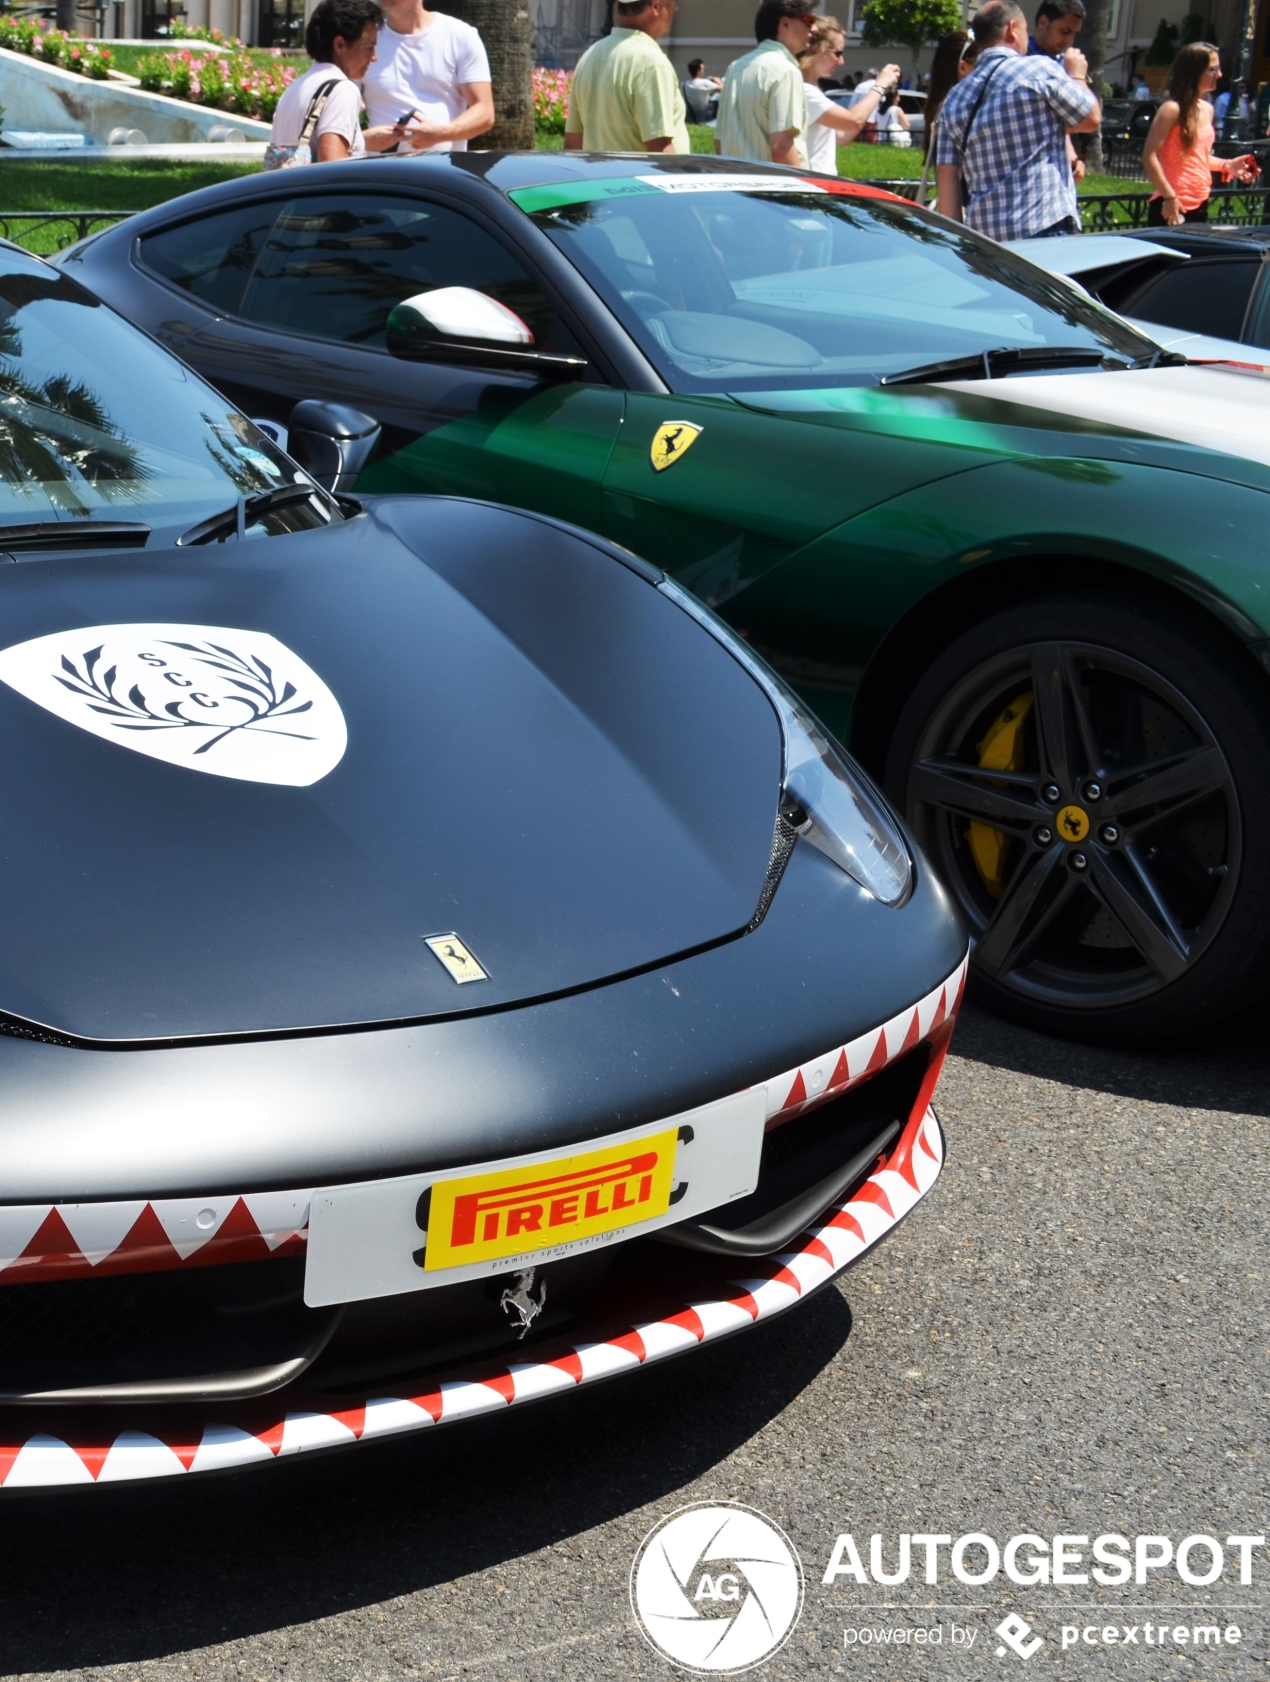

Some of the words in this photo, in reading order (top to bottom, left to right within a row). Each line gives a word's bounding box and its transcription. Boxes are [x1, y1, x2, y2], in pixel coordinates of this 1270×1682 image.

[450, 1151, 659, 1248] PIRELLI
[491, 1252, 535, 1269] premier
[541, 1243, 574, 1257] sports
[579, 1228, 626, 1246] solutions
